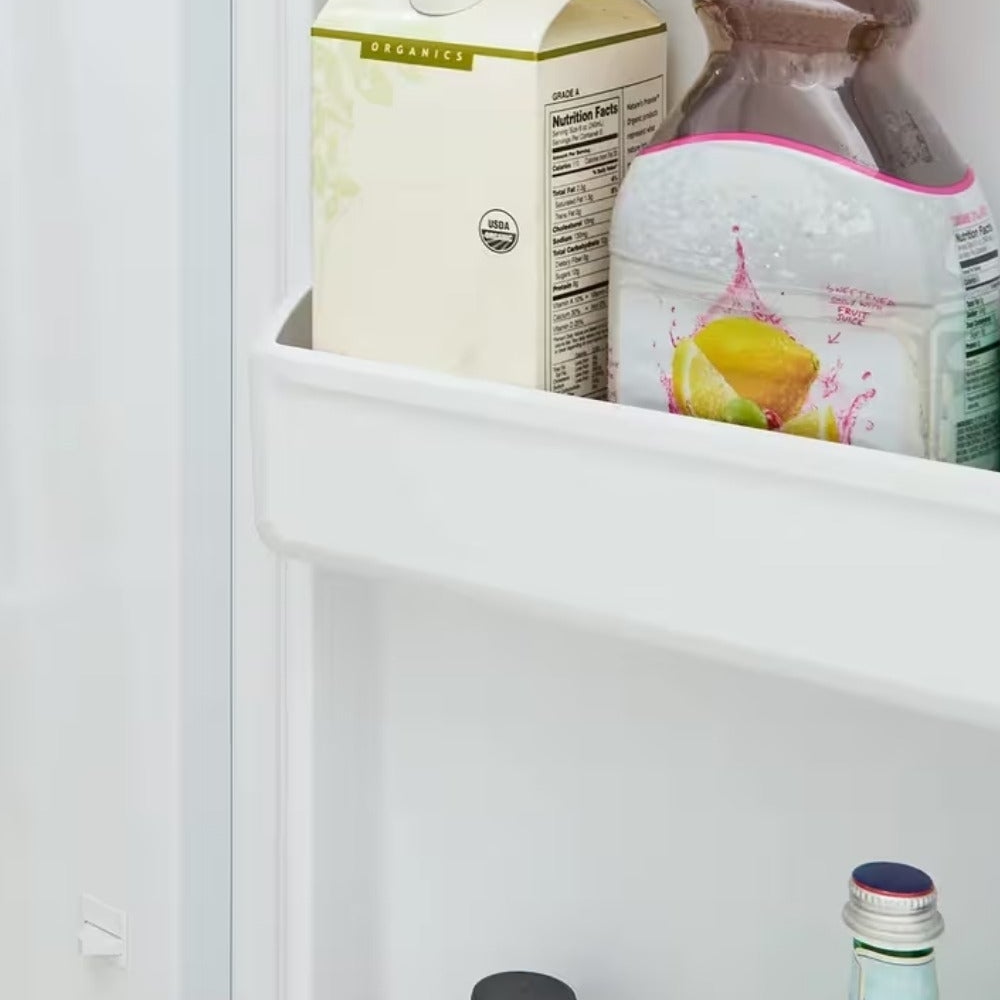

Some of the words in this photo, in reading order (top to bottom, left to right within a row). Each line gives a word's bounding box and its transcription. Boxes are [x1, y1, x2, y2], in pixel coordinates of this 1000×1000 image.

[370, 41, 463, 62] ORGANICS
[552, 88, 574, 101] GRADE
[553, 110, 593, 129] Nutrition
[594, 103, 618, 119] Facts
[553, 188, 565, 197] Total
[488, 219, 510, 231] USDA
[553, 221, 582, 233] Cholesterol
[553, 235, 572, 245] Sodium
[553, 248, 566, 256] Total
[567, 239, 600, 253] Carbohydrate
[553, 282, 571, 293] Protein
[837, 306, 870, 319] FRUIT
[836, 313, 865, 326] JUICE
